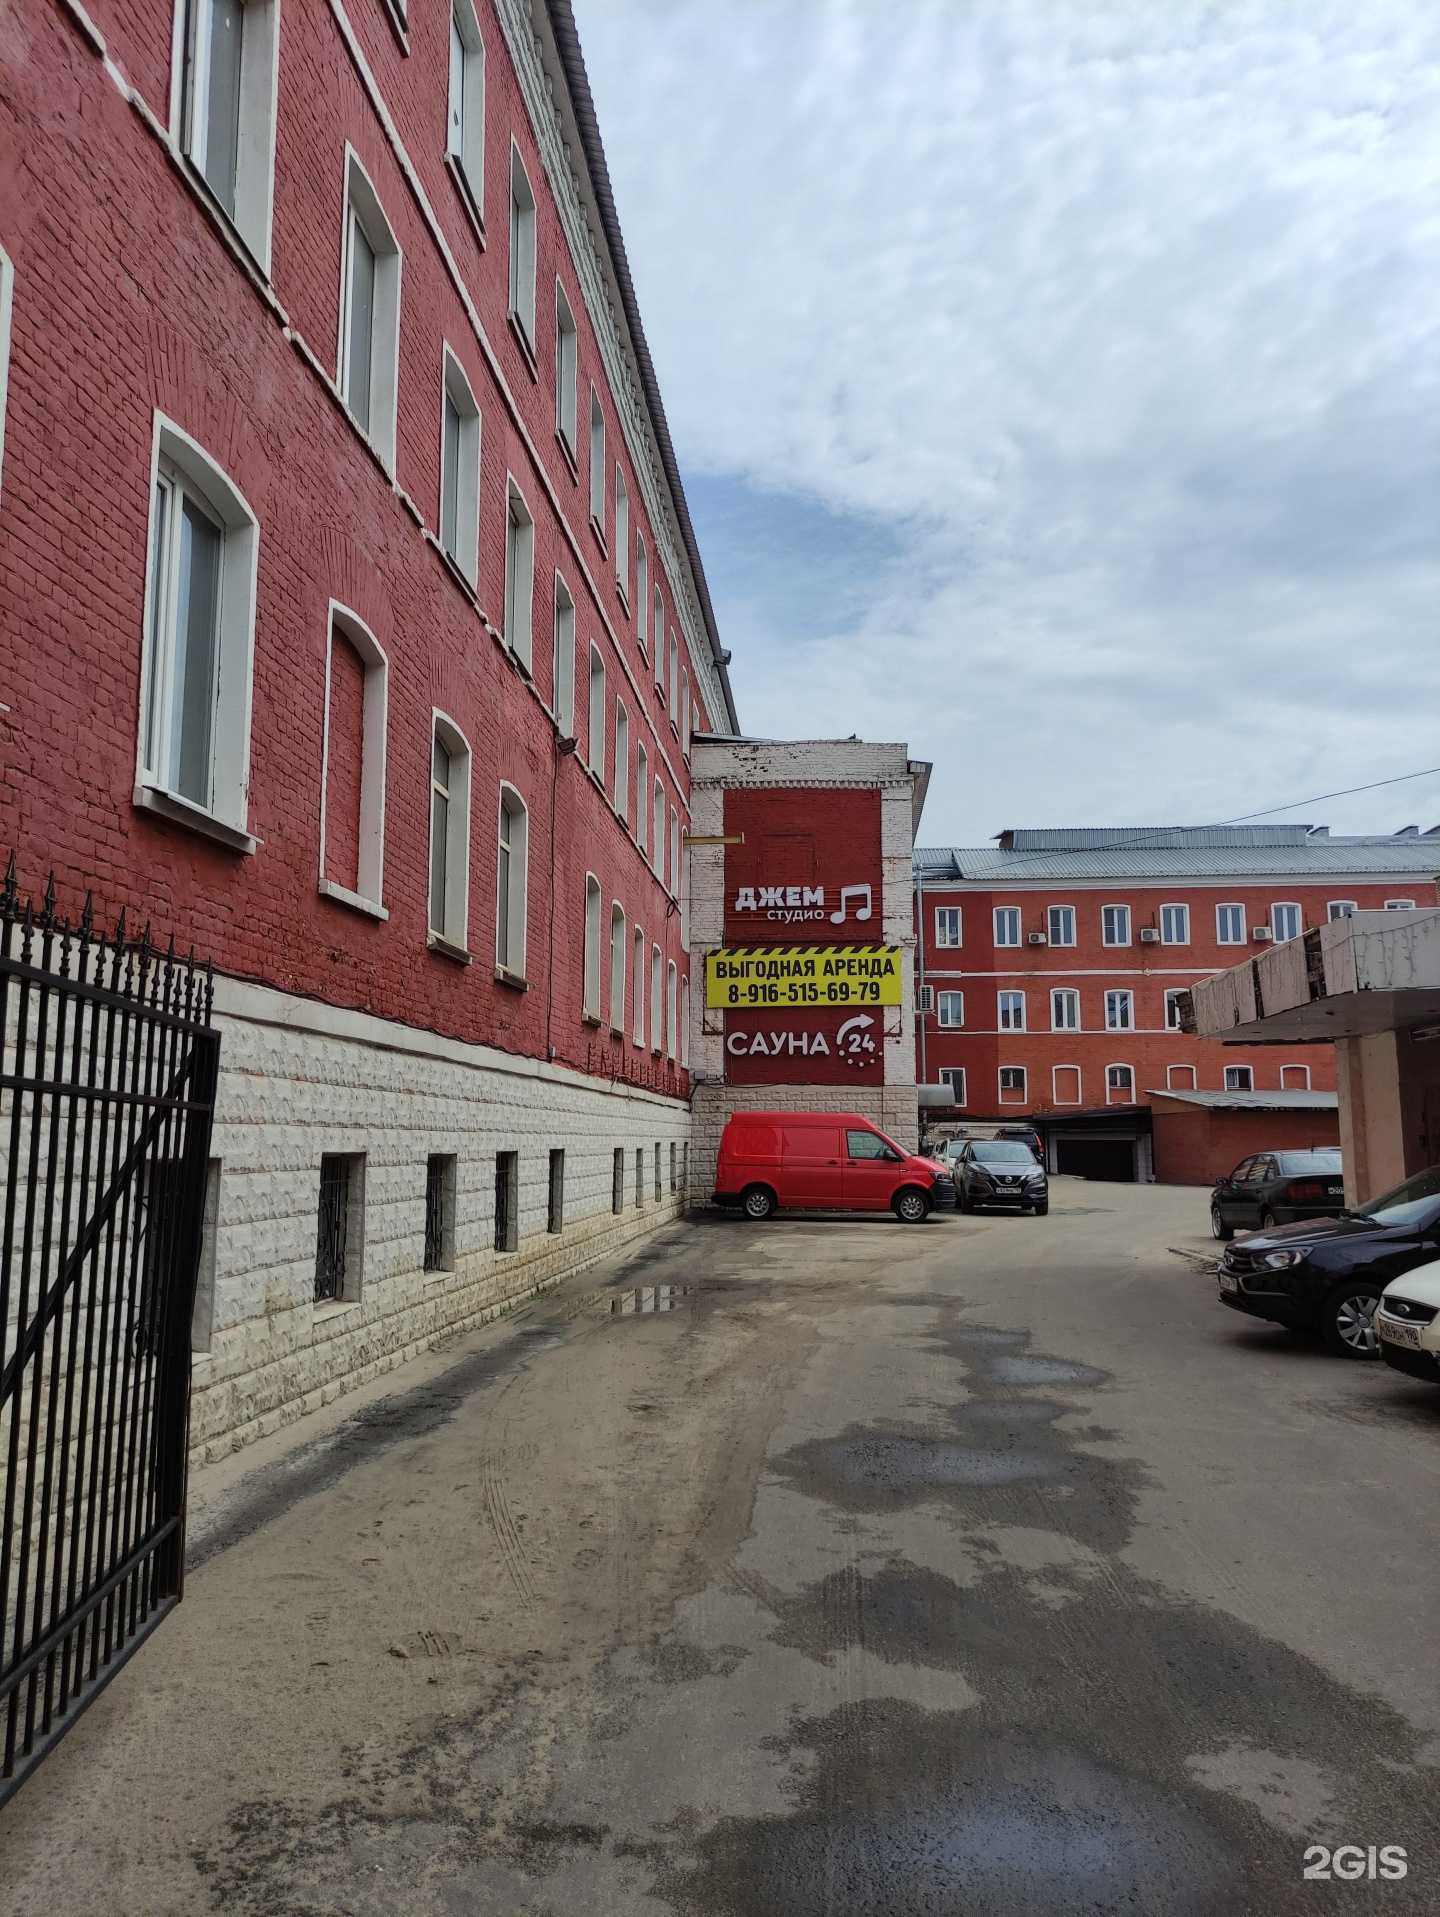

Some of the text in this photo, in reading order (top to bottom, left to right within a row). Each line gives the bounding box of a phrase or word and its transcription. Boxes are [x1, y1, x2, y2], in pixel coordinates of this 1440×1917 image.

[735, 886, 825, 911] ДЖЕМ
[767, 910, 825, 924] студио
[716, 958, 895, 980] ВЫГОДНАЯ АРЕНДА
[728, 982, 880, 1003] 8-916-515-69-79
[727, 1032, 876, 1056] САУНА 24
